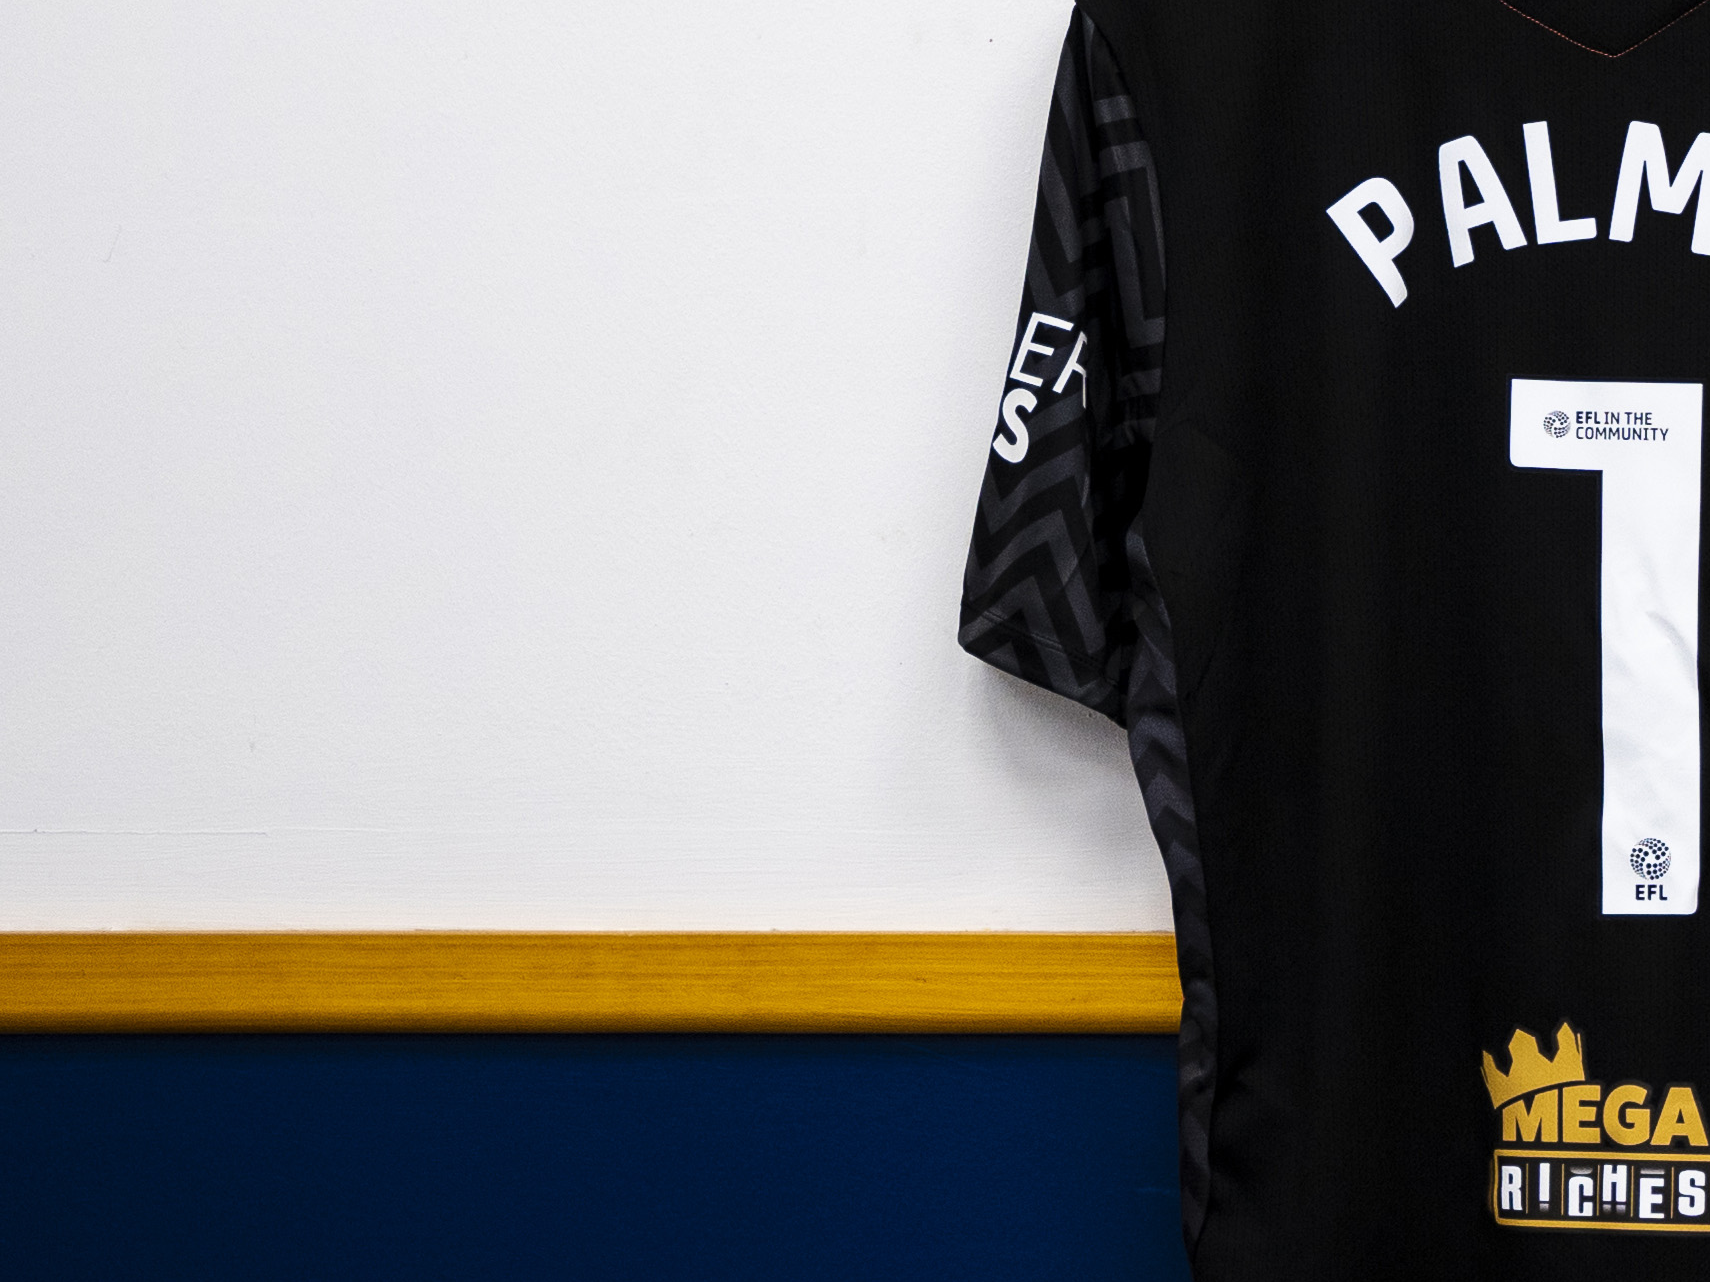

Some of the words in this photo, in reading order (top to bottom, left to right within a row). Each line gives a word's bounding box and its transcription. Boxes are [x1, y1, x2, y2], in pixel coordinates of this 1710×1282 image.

[1575, 411, 1601, 425] EFL
[1604, 411, 1620, 425] IN
[1624, 412, 1653, 425] THE
[1576, 426, 1669, 441] COMMUNITY
[1509, 378, 1703, 915] 1
[1635, 884, 1668, 901] EFL
[1502, 1084, 1709, 1146] MEGA
[1501, 1162, 1706, 1219] RICHES
